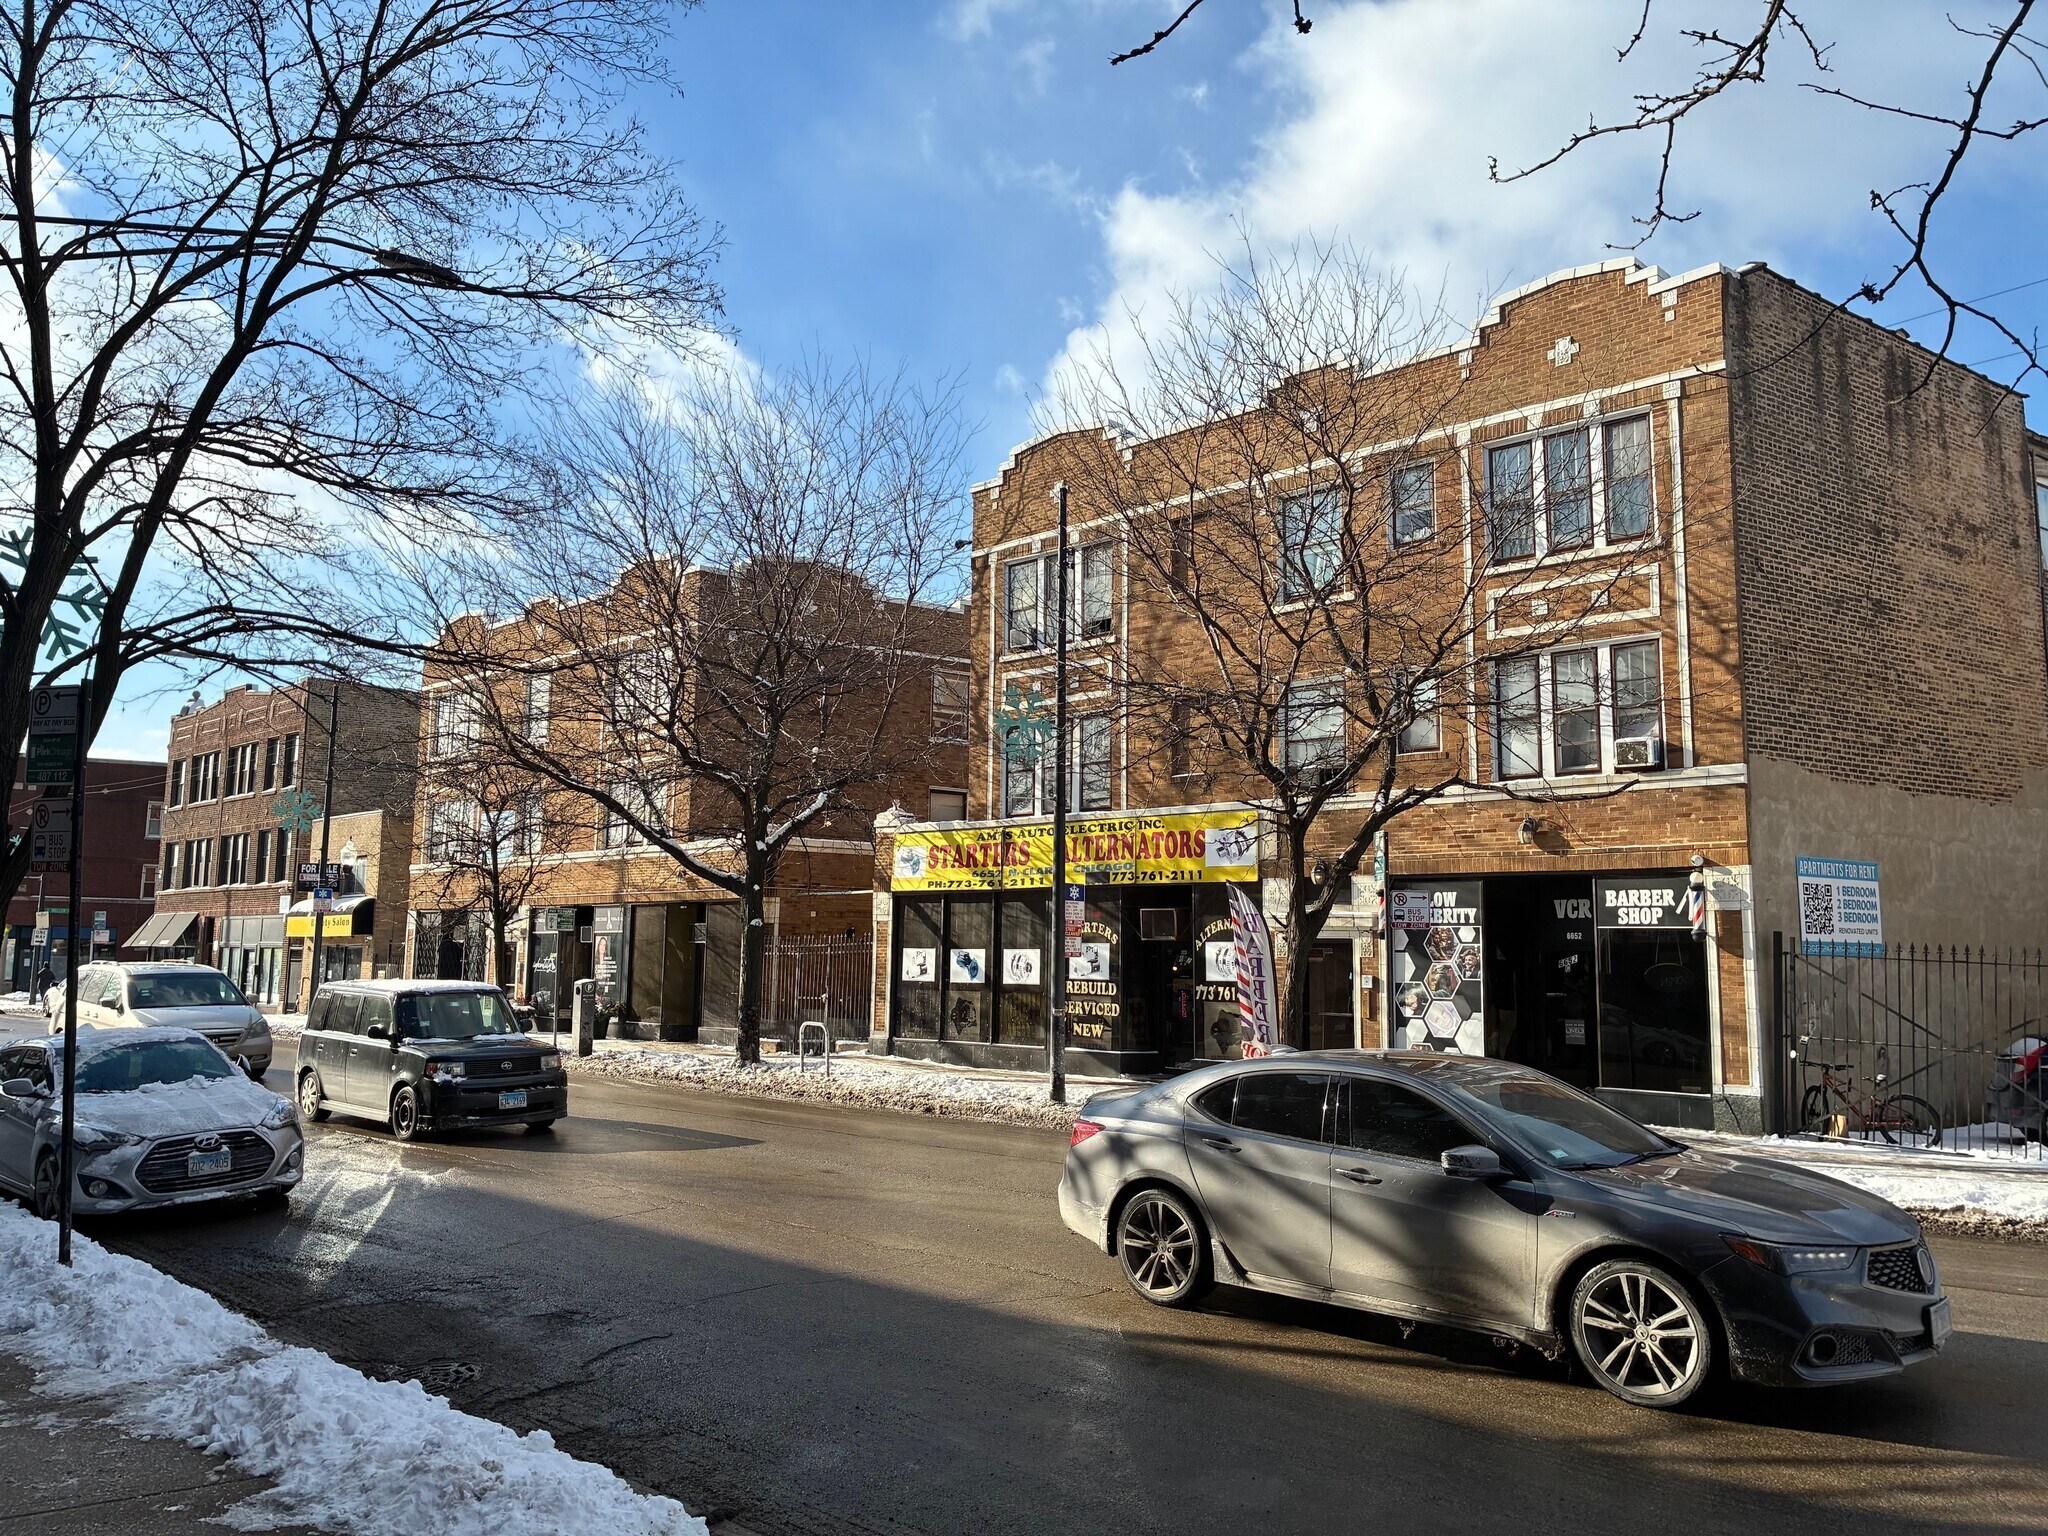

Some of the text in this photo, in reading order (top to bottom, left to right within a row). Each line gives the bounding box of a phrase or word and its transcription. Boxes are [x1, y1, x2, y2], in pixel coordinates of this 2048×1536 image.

[33, 720, 43, 728] PAY
[52, 719, 62, 727] PAY
[53, 771, 68, 782] 112
[1017, 828, 1054, 839] AUTO
[1065, 821, 1134, 835] ELECTRIC
[1138, 819, 1165, 830] INC.
[48, 834, 64, 846] BUS
[48, 847, 67, 859] STOP
[927, 841, 1031, 869] STARTERS
[32, 860, 68, 871] TOW ZONE
[301, 864, 317, 873] FOR
[971, 870, 1001, 879] 6652
[1022, 867, 1054, 876] CLAR
[1073, 862, 1134, 873] CHICAGO
[1799, 860, 1876, 880] APARTMENTS FOR RENT
[1111, 870, 1203, 882] 773-761-2111
[1604, 888, 1676, 908] BARBER
[1836, 885, 1877, 899] 1 BEDROOM
[1553, 898, 1593, 919] VCR
[1836, 899, 1878, 912] 2 BEDROOM
[332, 917, 350, 927] Salon
[1617, 907, 1664, 925] SHOP
[1837, 911, 1879, 924] 3 BEDROOM
[1081, 921, 1119, 945] RTERS
[1838, 927, 1865, 935] RENOVATED
[1066, 980, 1117, 996] REBUILD
[1064, 1000, 1120, 1017] SERVICED
[1072, 1022, 1104, 1038] NEW
[209, 1157, 229, 1170] 2405
